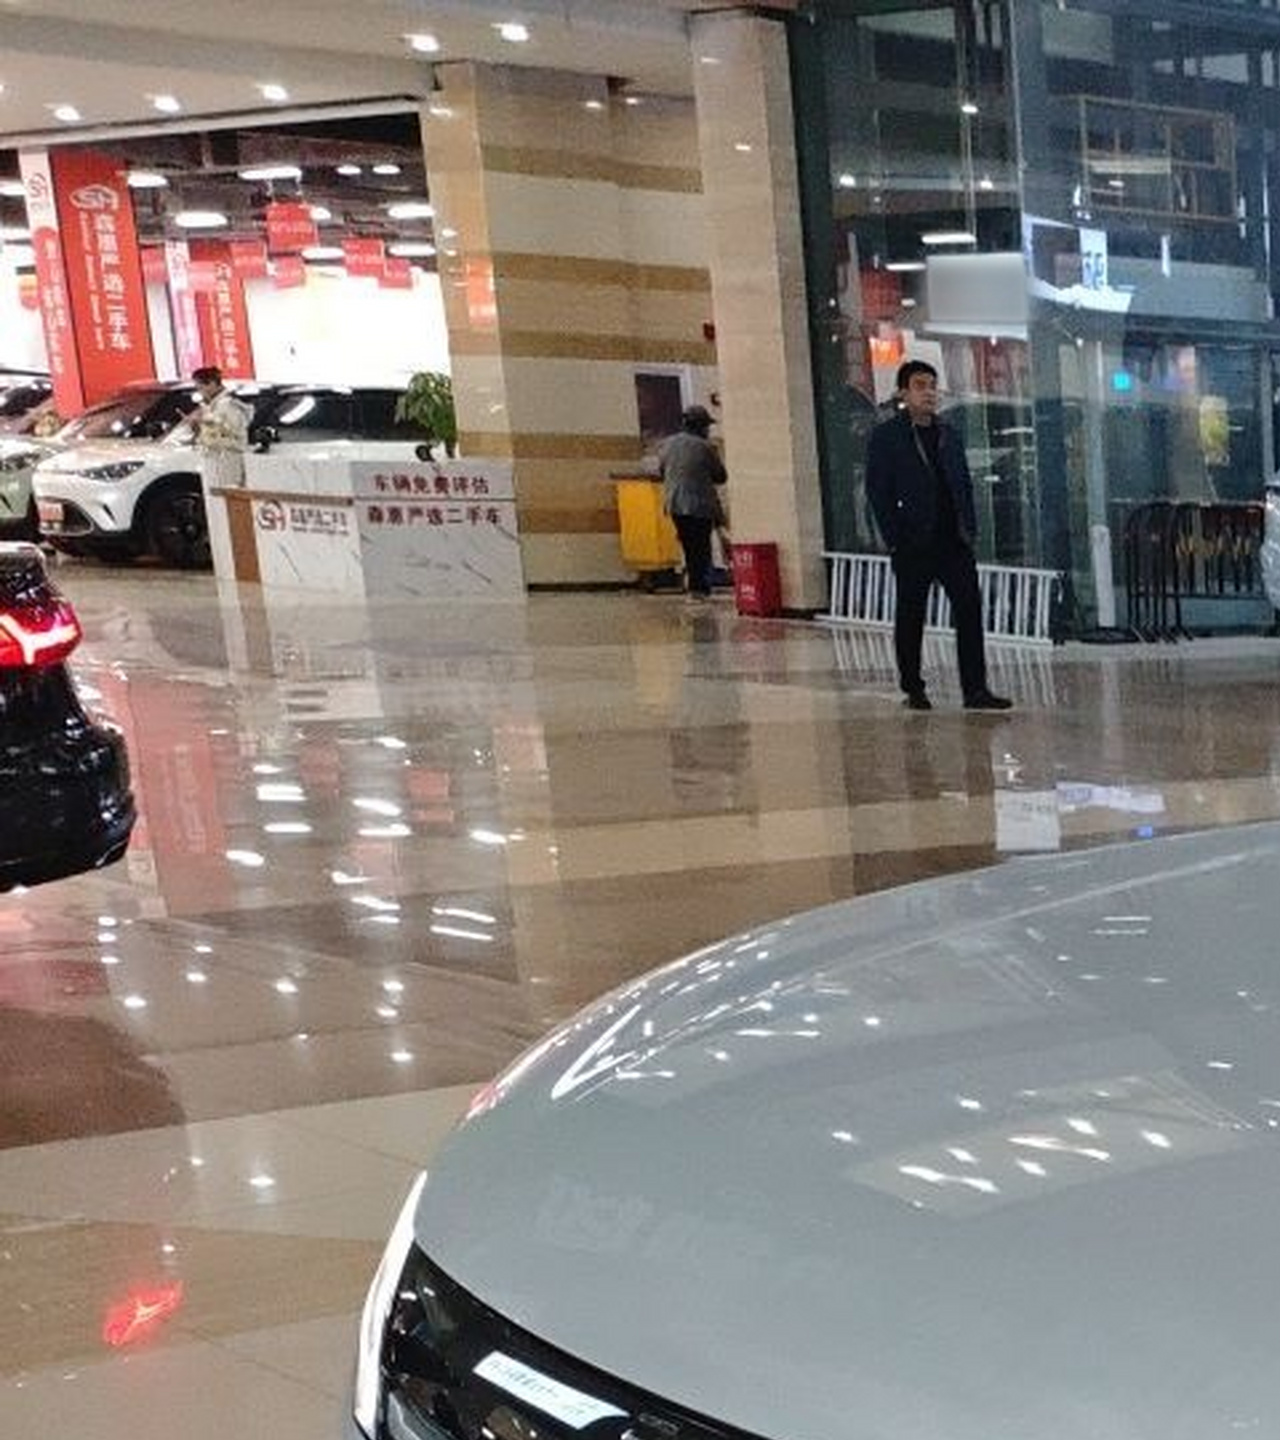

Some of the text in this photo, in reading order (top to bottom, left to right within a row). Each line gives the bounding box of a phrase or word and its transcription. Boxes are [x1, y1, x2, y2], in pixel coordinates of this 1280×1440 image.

[372, 473, 490, 495] 车辆免费评估
